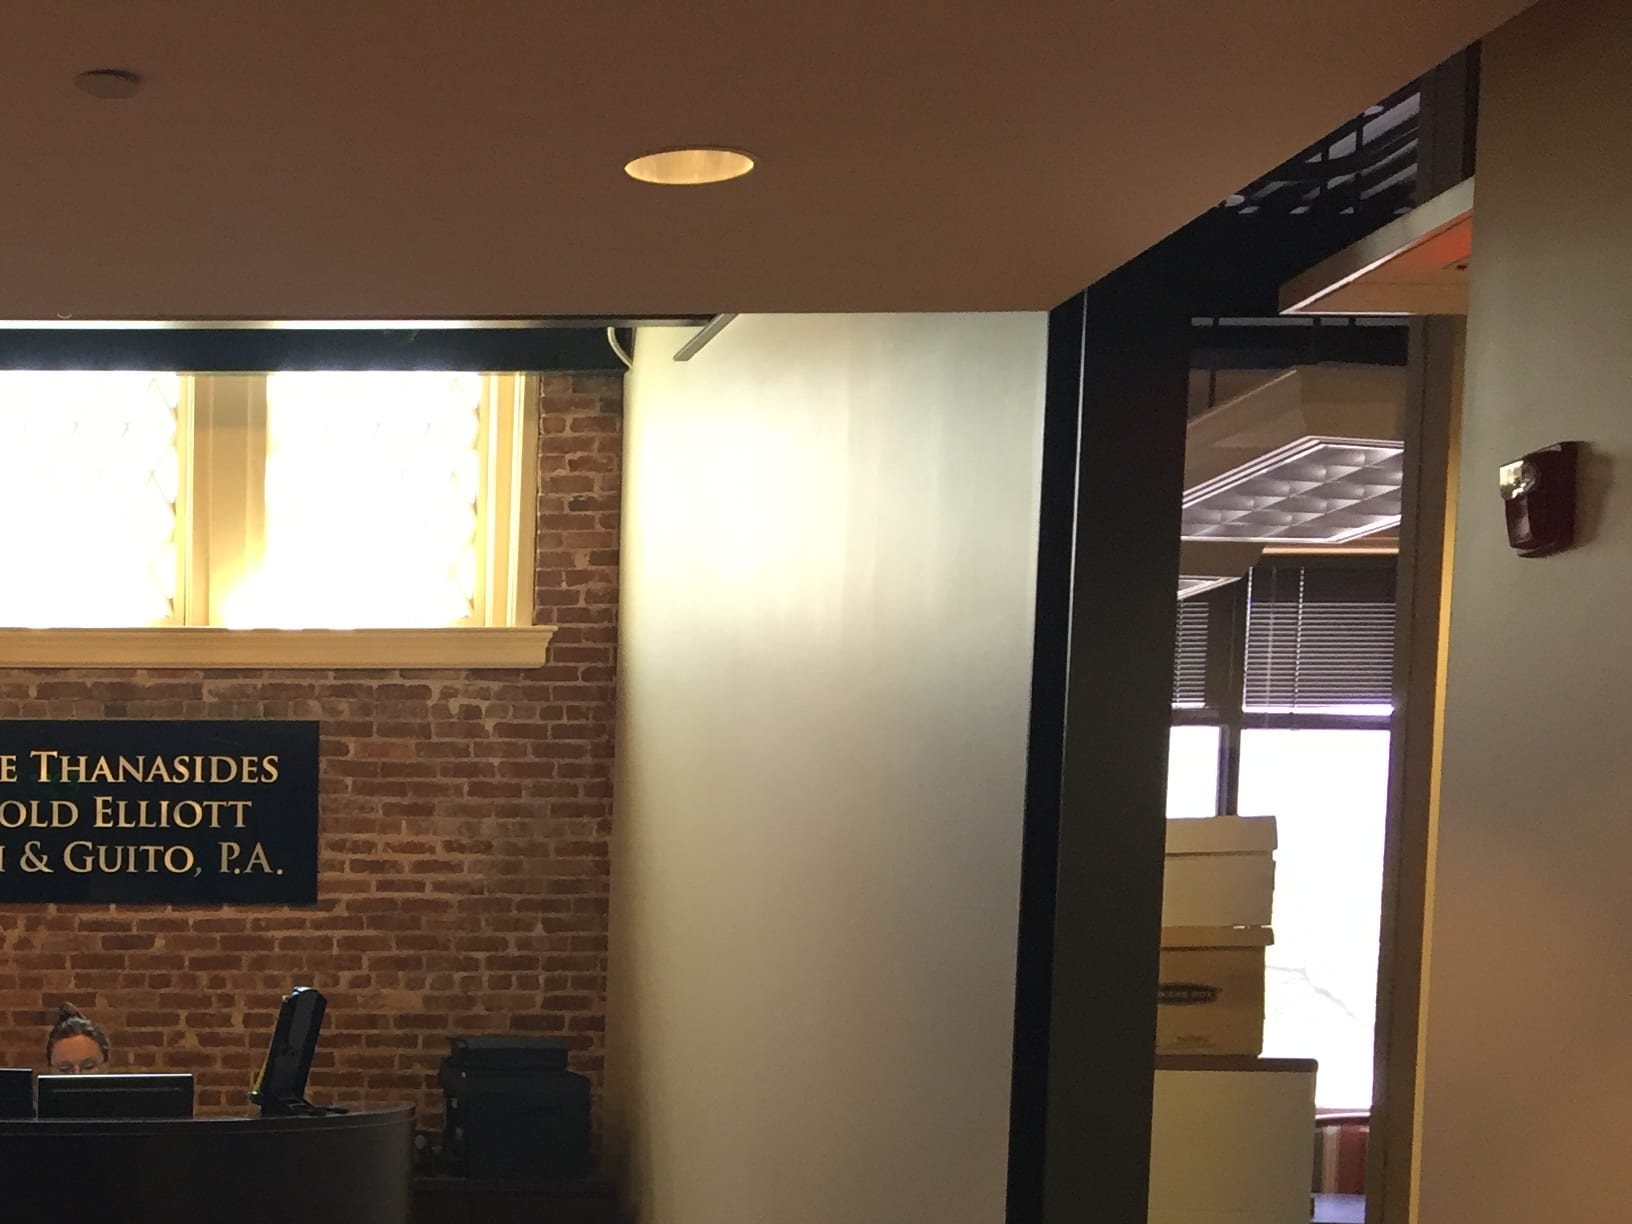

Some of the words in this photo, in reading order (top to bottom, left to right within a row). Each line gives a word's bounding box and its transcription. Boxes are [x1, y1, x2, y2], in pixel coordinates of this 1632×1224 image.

[29, 751, 279, 783] THANASIDES
[93, 796, 253, 827] ELLIOTT
[19, 841, 54, 873] &
[63, 841, 202, 877] GUITO,
[220, 842, 283, 875] P.A.
